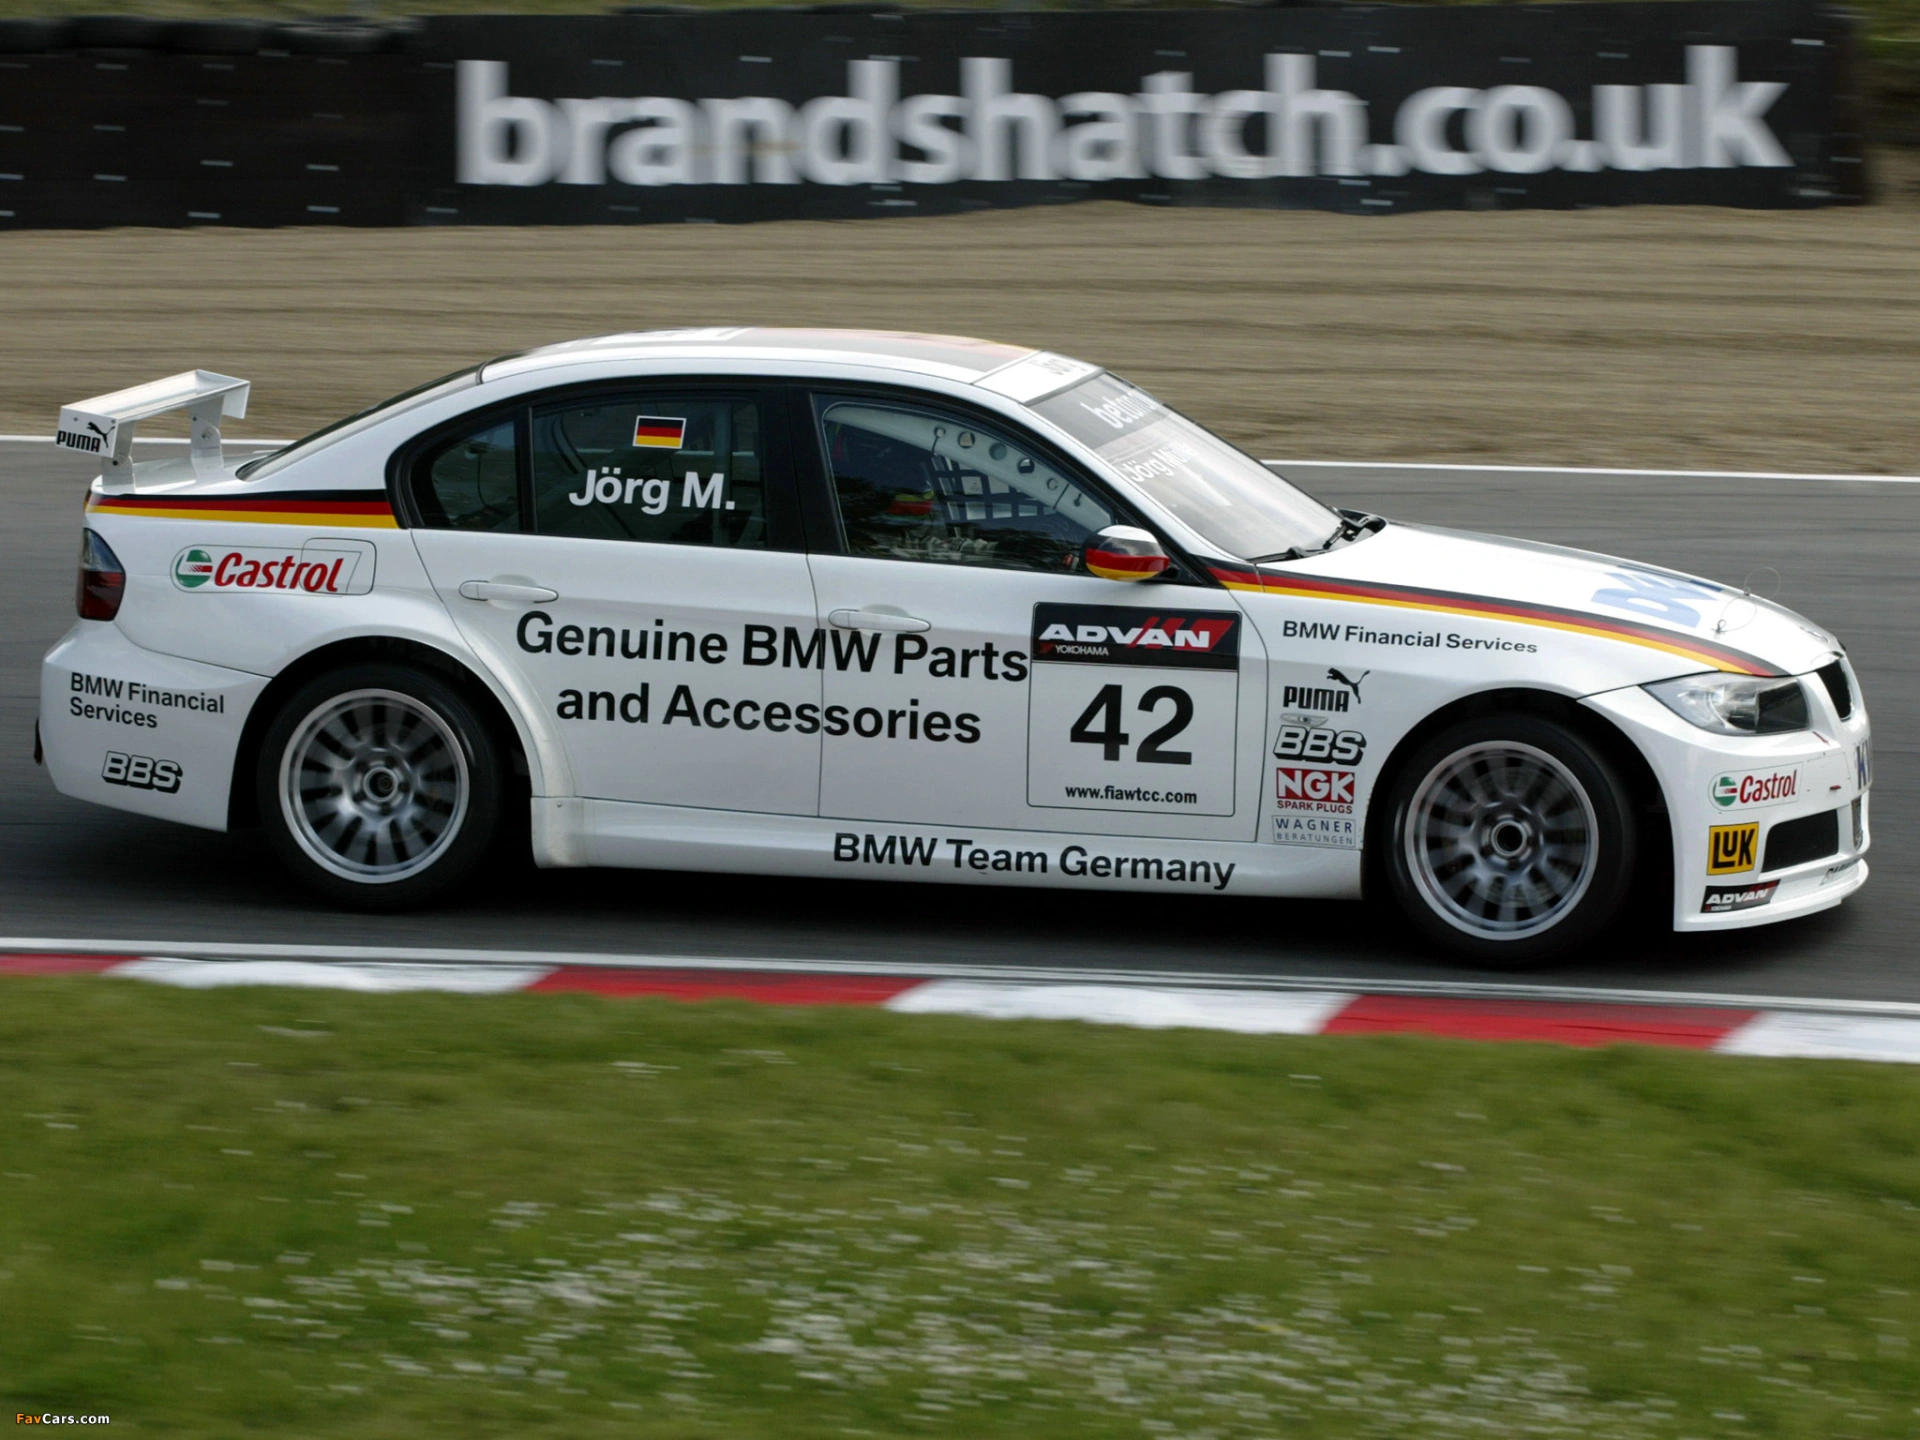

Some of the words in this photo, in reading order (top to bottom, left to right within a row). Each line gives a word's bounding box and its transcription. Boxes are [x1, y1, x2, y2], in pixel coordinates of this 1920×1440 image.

[456, 45, 1794, 187] brandshatch.co.uk
[56, 430, 101, 453] PUMA
[568, 467, 670, 515] Jörg
[682, 471, 735, 510] M.
[214, 552, 344, 592] Castrol
[516, 611, 728, 664] Genuine
[743, 624, 881, 673] BMW
[894, 633, 1029, 682] Parts
[1038, 623, 1210, 649] ADVAN
[1055, 645, 1109, 656] YOKOHAMA
[1282, 620, 1340, 641] BMW
[1345, 625, 1440, 648] Financial
[1445, 634, 1538, 653] Services
[70, 672, 123, 699] BMW
[129, 683, 225, 714] Financial
[1283, 686, 1350, 713] PUMA
[70, 697, 158, 728] Services
[557, 683, 650, 724] and
[663, 684, 981, 744] Accessories
[1070, 683, 1194, 765] 42
[1273, 725, 1367, 766] BBS
[102, 751, 183, 793] BBS
[1277, 768, 1355, 803] NGK
[1739, 769, 1797, 804] Castrol
[1065, 785, 1197, 804] www.fiawtcc.com
[1277, 801, 1314, 812] SPARK
[1316, 803, 1353, 814] PLUGS
[1275, 818, 1353, 834] WAGNER
[1276, 832, 1353, 845] BERATUNGEN
[833, 832, 938, 866] BMW
[946, 838, 1048, 873] Team
[1059, 845, 1236, 890] Germany
[1705, 889, 1768, 904] ADVAN
